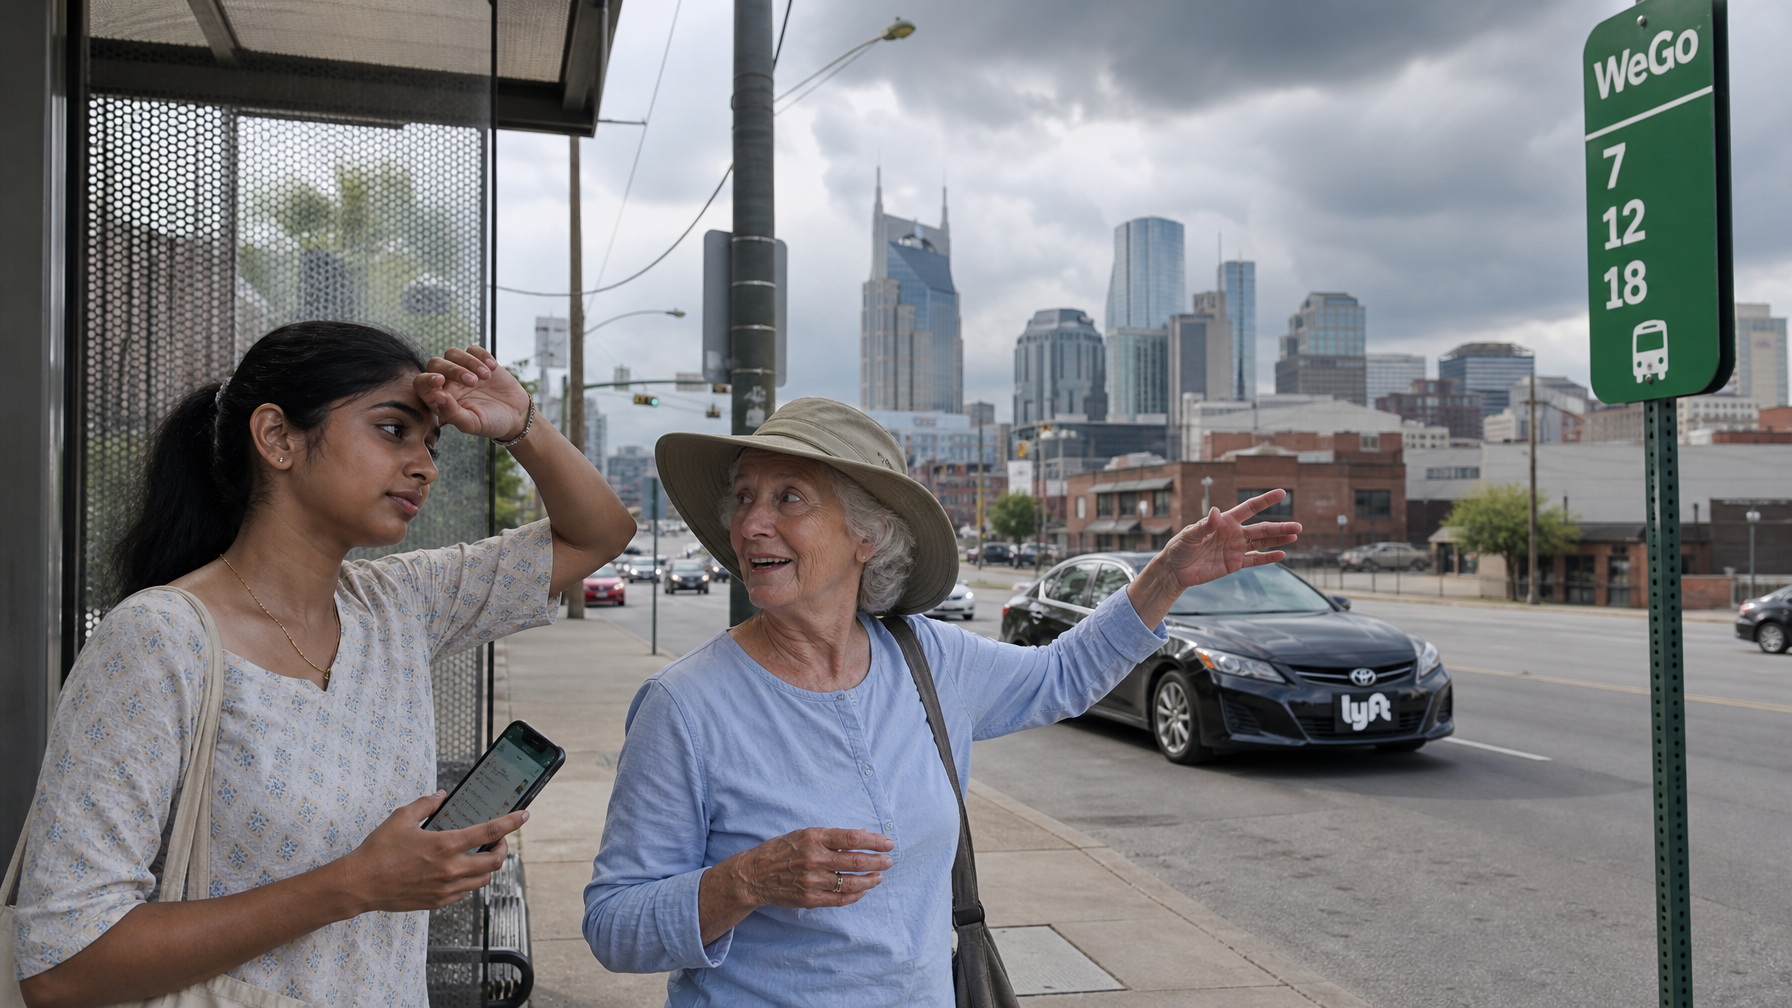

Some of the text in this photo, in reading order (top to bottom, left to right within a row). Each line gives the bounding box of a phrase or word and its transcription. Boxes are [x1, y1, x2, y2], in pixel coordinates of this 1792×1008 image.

[1593, 28, 1699, 100] WeGo
[1602, 141, 1626, 190] 7
[1602, 198, 1646, 251] 12
[1603, 259, 1648, 310] 18
[1341, 692, 1392, 731] lyft
